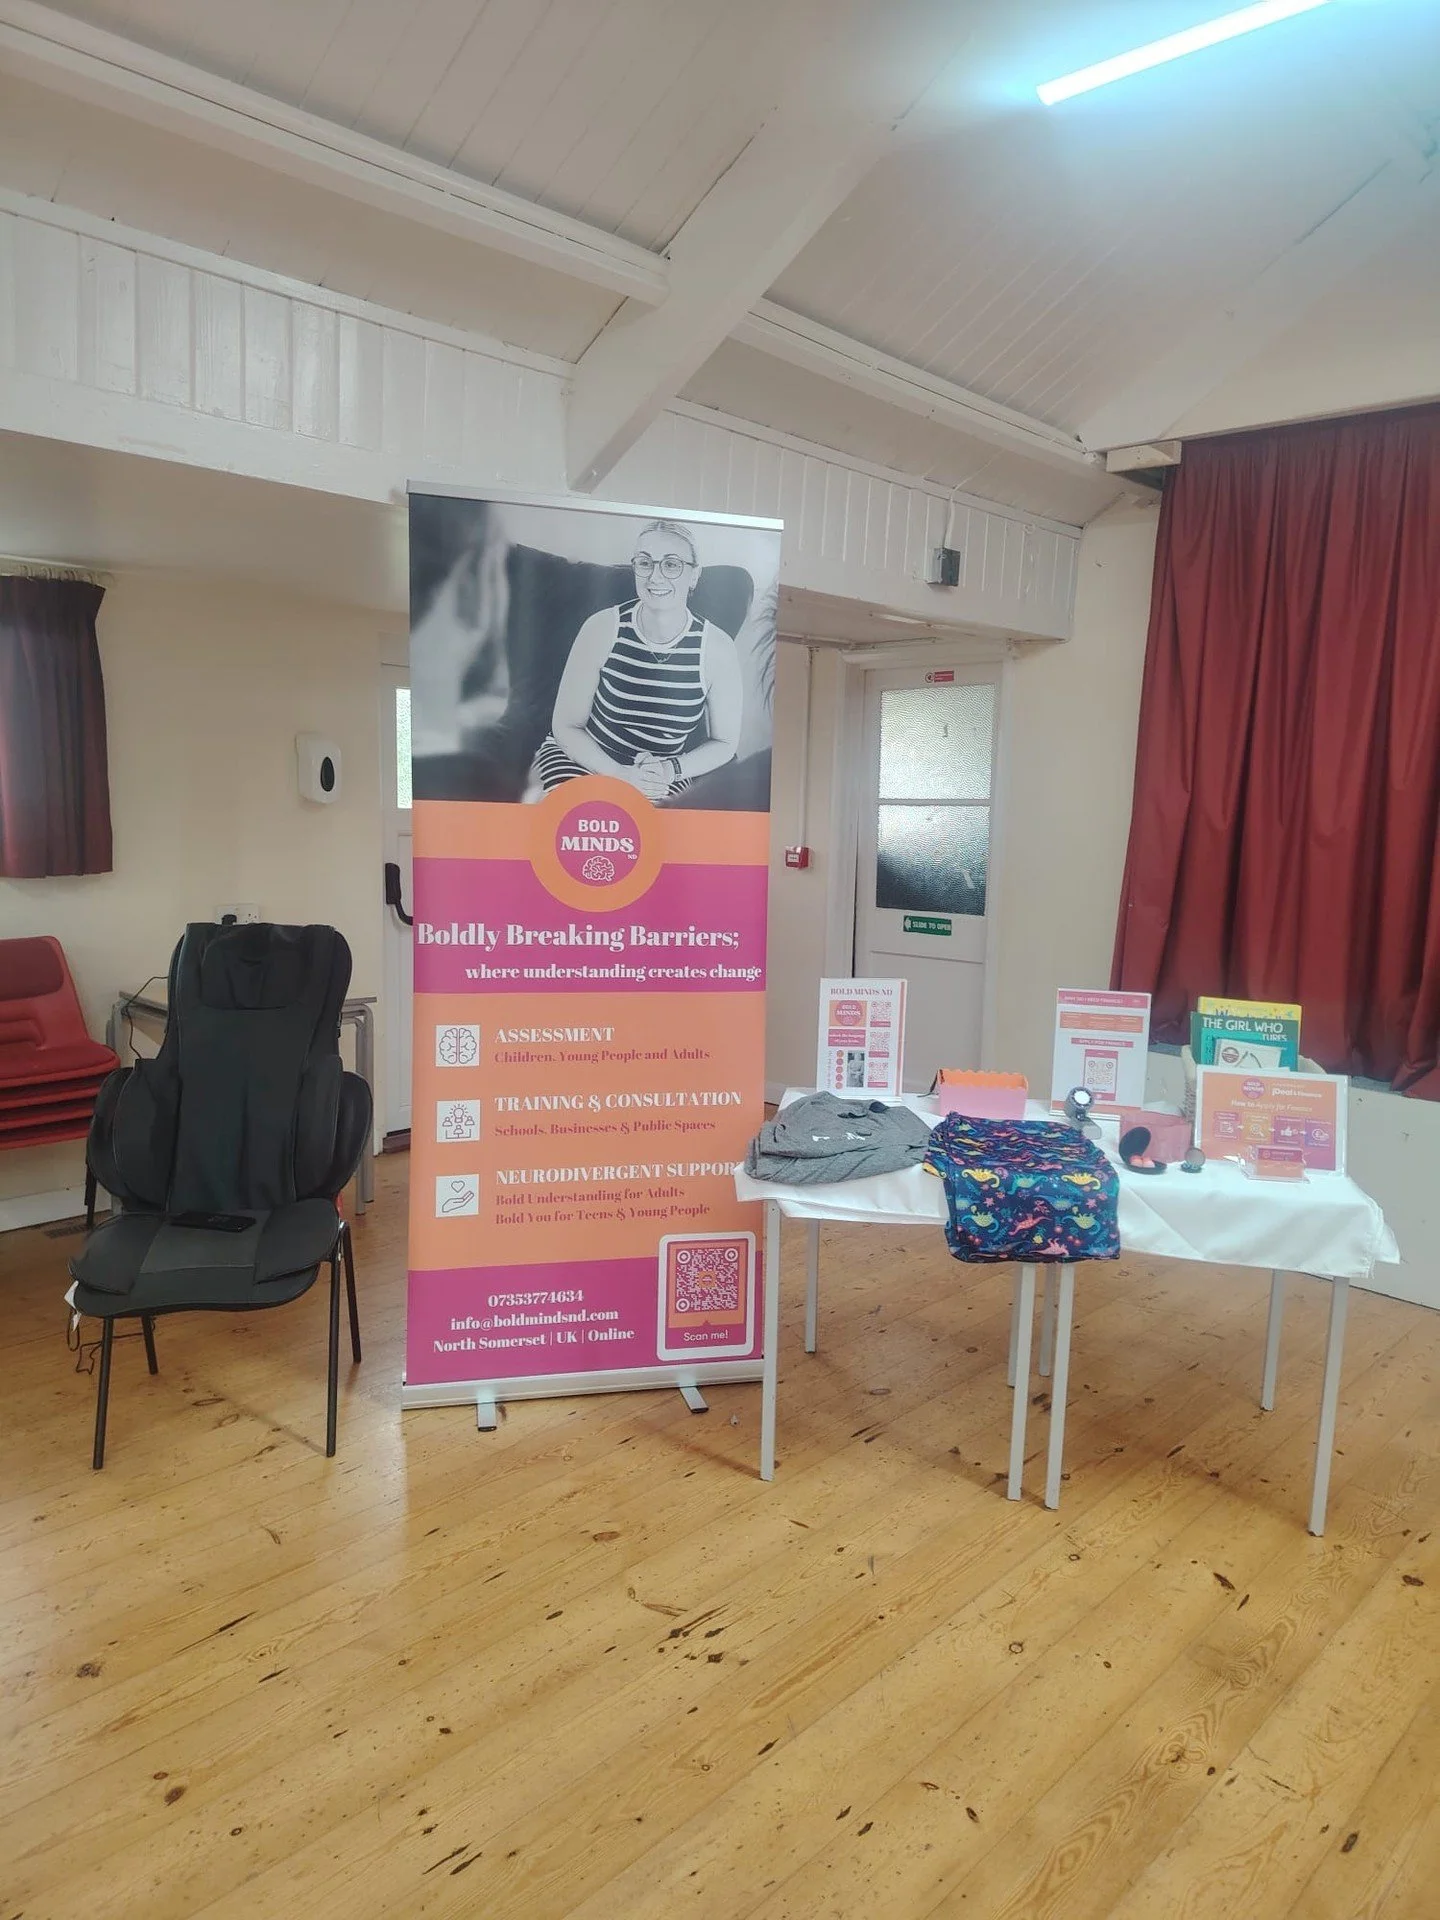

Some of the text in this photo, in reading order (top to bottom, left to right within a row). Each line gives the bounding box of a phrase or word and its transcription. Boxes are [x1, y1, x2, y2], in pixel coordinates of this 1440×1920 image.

[578, 820, 619, 833] BOLD
[560, 837, 634, 853] MINDS
[418, 923, 739, 952] Boldly Breaking Barriers;
[466, 964, 762, 982] where understanding creates change
[1203, 1017, 1283, 1033] THE GIRL WHO
[495, 1027, 615, 1043] ASSESSMENT
[1261, 1034, 1287, 1042] TURES
[559, 1051, 599, 1064] Young
[601, 1050, 642, 1063] People
[644, 1050, 668, 1060] and
[670, 1049, 710, 1060] Adults
[495, 1091, 742, 1112] TRAINING & CONSULTATION
[550, 1122, 618, 1135] Businesses
[620, 1122, 630, 1134] &
[632, 1120, 672, 1132] Public
[674, 1120, 716, 1133] Spaces
[496, 1161, 742, 1186] NEURODIVERGENT SUPPOR
[496, 1186, 685, 1206] Bold Understanding for Adults
[496, 1204, 710, 1225] Bold You for Teens & Young People
[487, 1289, 584, 1308] 07353774634
[450, 1308, 619, 1332] info@boldmindsnd.com
[433, 1338, 476, 1353] North
[479, 1333, 546, 1349] Somerset
[557, 1331, 578, 1344] UK
[588, 1327, 635, 1342] Online
[683, 1330, 728, 1342] Scan me!
